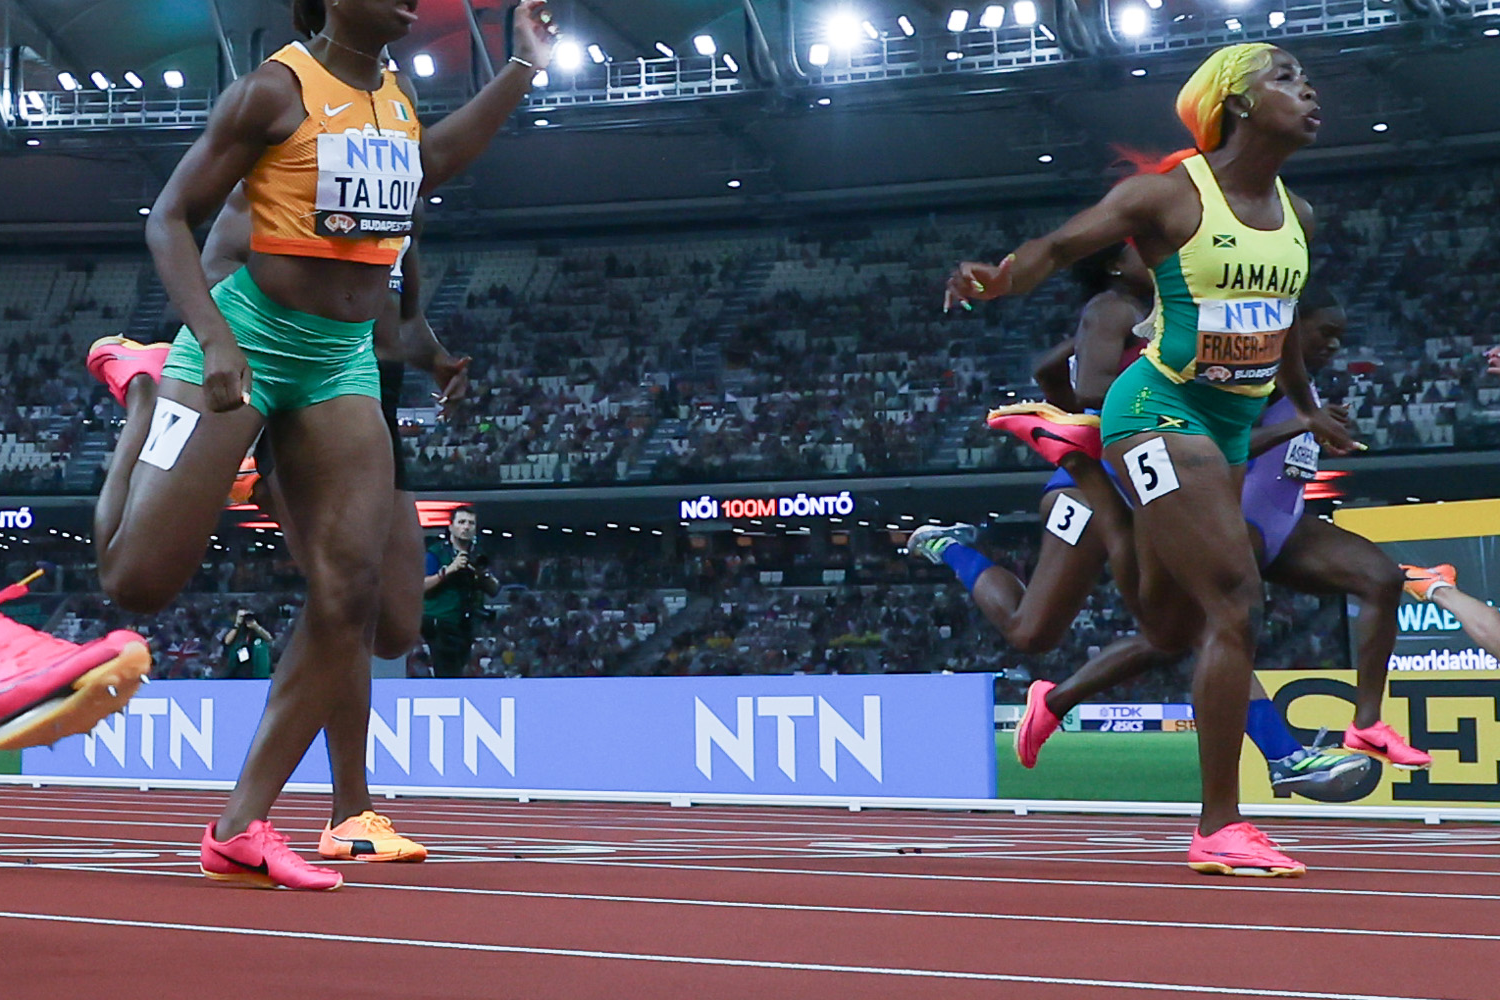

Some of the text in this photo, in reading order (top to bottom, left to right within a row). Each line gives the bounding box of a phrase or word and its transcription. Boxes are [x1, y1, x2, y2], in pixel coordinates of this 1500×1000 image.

[346, 137, 410, 173] NTN
[335, 177, 415, 210] TA LOU
[1225, 301, 1282, 329] NTN
[149, 411, 181, 451] 7
[1137, 452, 1159, 491] 5
[721, 498, 776, 518] 100M
[1057, 505, 1075, 531] 3
[1109, 706, 1142, 717] TDK
[84, 697, 214, 771] NTN
[366, 697, 515, 777] NTN
[695, 695, 883, 784] NTN
